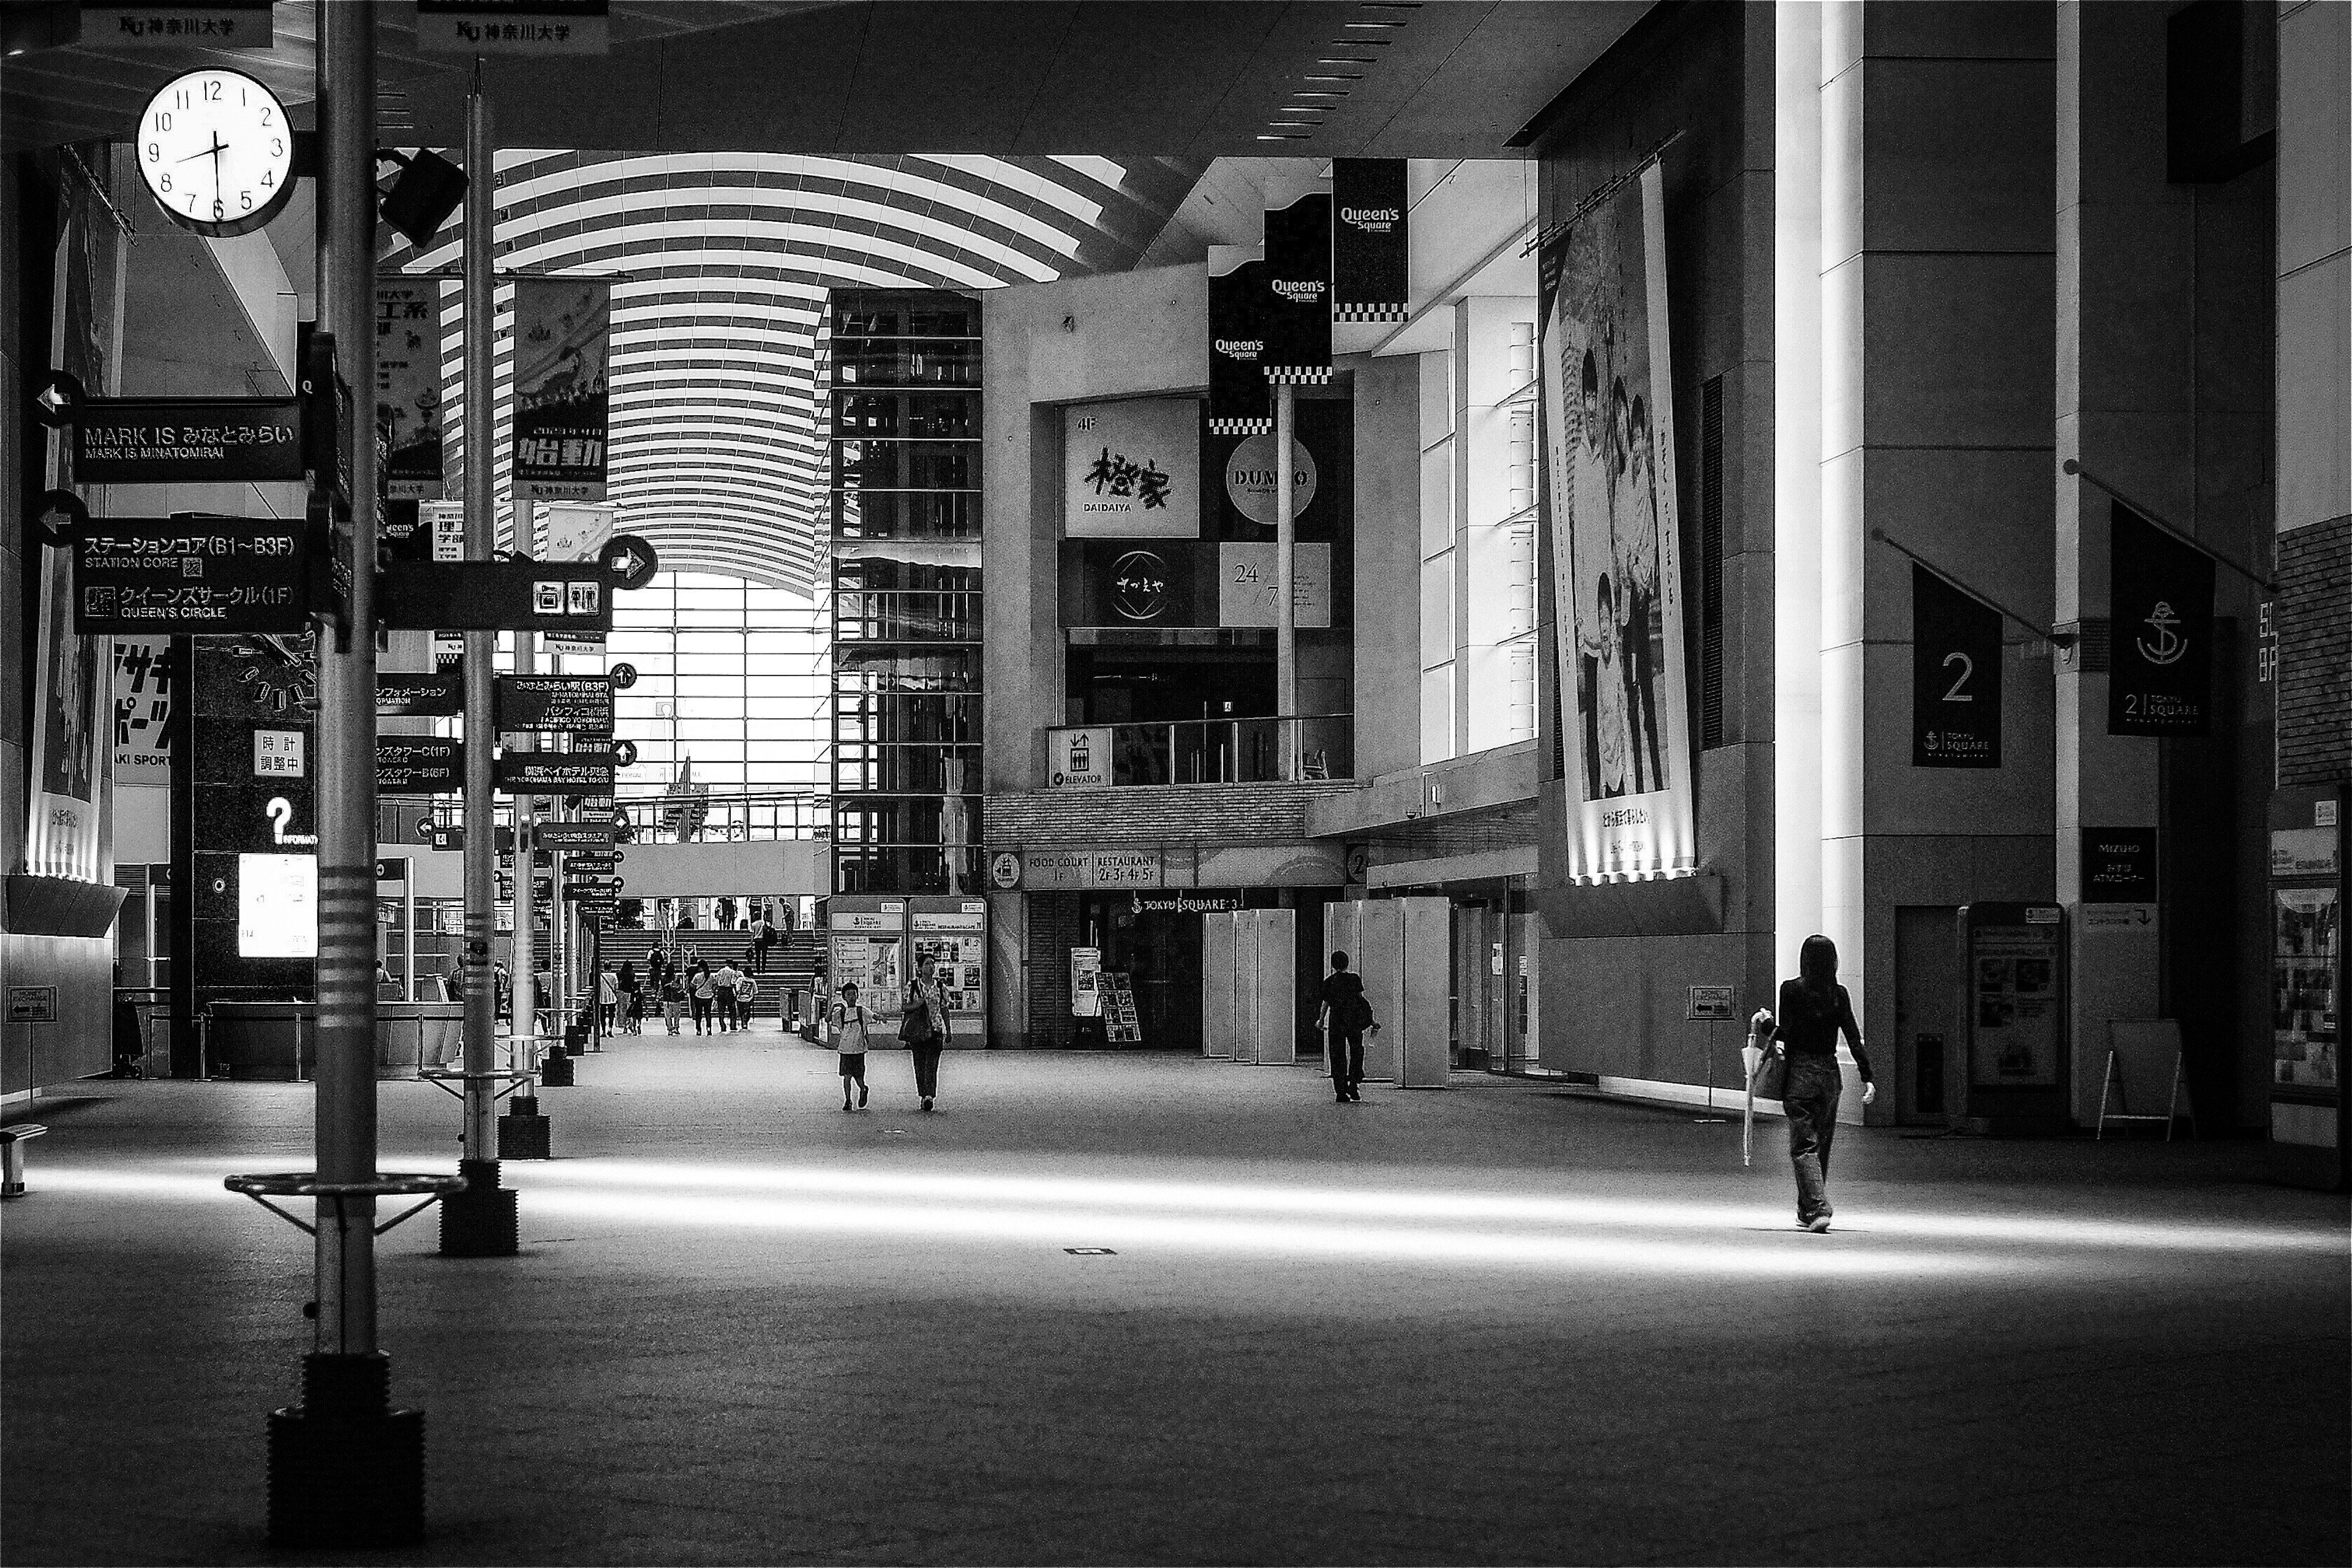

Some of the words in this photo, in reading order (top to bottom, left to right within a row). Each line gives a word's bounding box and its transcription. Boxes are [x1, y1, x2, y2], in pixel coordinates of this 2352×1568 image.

[486, 23, 570, 40] 神奈川大学
[204, 81, 221, 100] 12
[243, 88, 246, 107] 1
[176, 90, 189, 110] 11
[156, 112, 172, 132] 10
[260, 107, 271, 126] 2
[149, 143, 159, 162] 9
[271, 138, 283, 157] 3
[160, 174, 172, 192] 8
[260, 170, 274, 188] 4
[184, 194, 196, 213] 7
[241, 191, 252, 209] 5
[214, 200, 224, 219] 6
[1341, 208, 1399, 224] Queen's
[1358, 221, 1392, 233] Square
[1272, 279, 1325, 295] Queen's
[1287, 292, 1317, 303] Square
[1215, 339, 1264, 353] Queen's
[1229, 350, 1257, 360] Square
[302, 380, 313, 394] Q
[1078, 418, 1096, 430] 4F
[85, 428, 148, 445] MARK
[155, 428, 175, 445] IS
[183, 426, 294, 446] みなとみらい
[85, 447, 121, 459] MARK
[125, 447, 138, 459] IS
[141, 447, 224, 459] MINATOMIRAI
[1235, 470, 1308, 486] DUMO
[1084, 503, 1132, 512] DAIDAIYA
[85, 557, 140, 568] STATION
[143, 557, 178, 568] CORE
[121, 586, 292, 605] クイーンズサークル(1F)
[121, 608, 177, 619] QUEEN'S
[181, 608, 227, 619] CIRCLE
[1942, 652, 1973, 702] 2
[2125, 693, 2138, 714] 2
[2150, 705, 2199, 717] SQUARE
[263, 736, 296, 752] 時計
[1947, 741, 1989, 752] SQUARE
[260, 756, 298, 772] 調整中
[1065, 774, 1102, 785] ELEVATOR
[2098, 844, 2140, 853] MIZUHO
[1030, 858, 1055, 867] FOOD
[1058, 858, 1088, 867] COURT
[1098, 857, 1155, 866] RESTAURANT
[1354, 853, 1366, 875] 2
[1054, 870, 1064, 881] 1F
[1099, 868, 1111, 881] 2F
[1114, 868, 1125, 881] 3F
[1128, 868, 1139, 881] 4F
[1142, 868, 1155, 881] 5F
[1144, 901, 1176, 911] TOKYU
[1182, 900, 1227, 912] SQUARE
